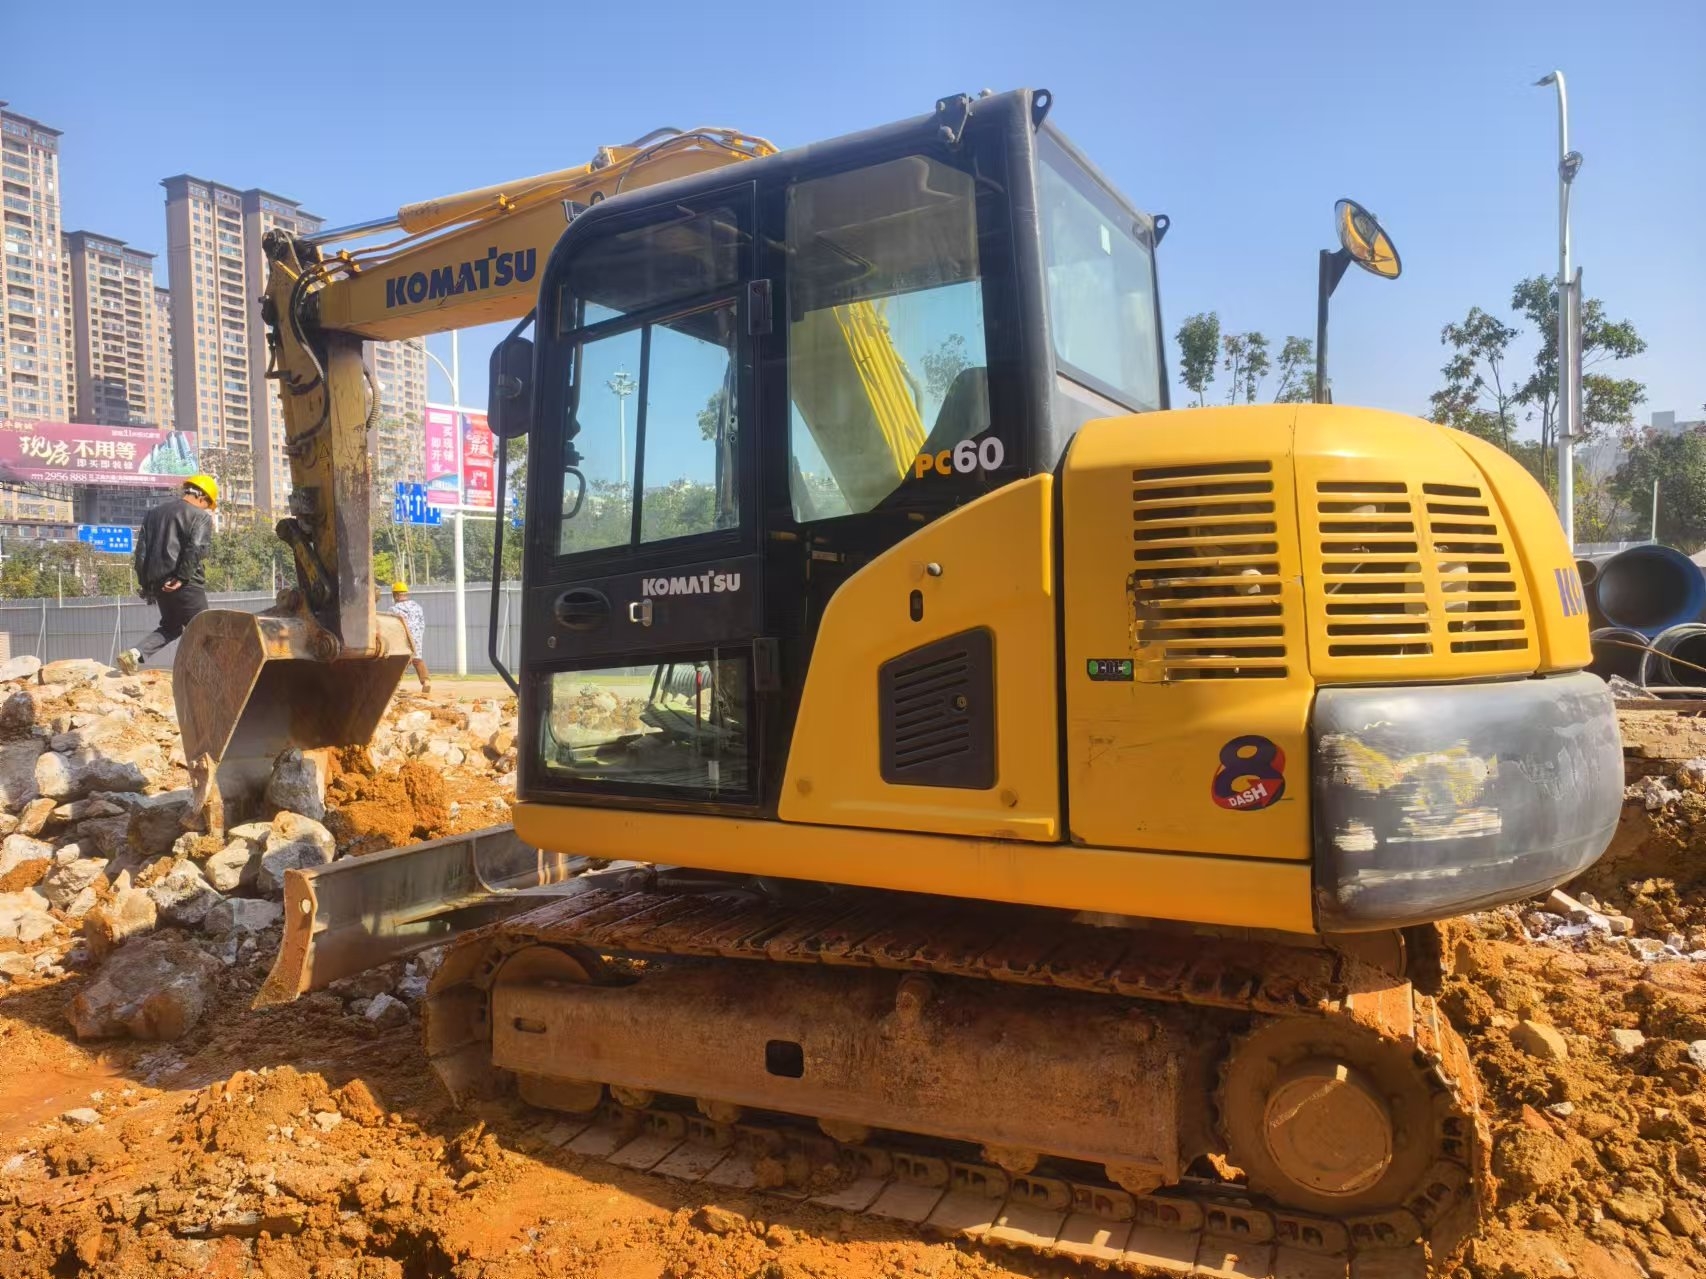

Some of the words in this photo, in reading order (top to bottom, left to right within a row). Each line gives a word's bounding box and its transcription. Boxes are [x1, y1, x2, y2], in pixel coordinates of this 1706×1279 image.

[386, 246, 537, 309] KOMATSU
[915, 436, 1005, 479] PC60
[642, 570, 741, 597] KOMATSU
[1213, 735, 1286, 811] 8
[1227, 783, 1268, 808] DASH
